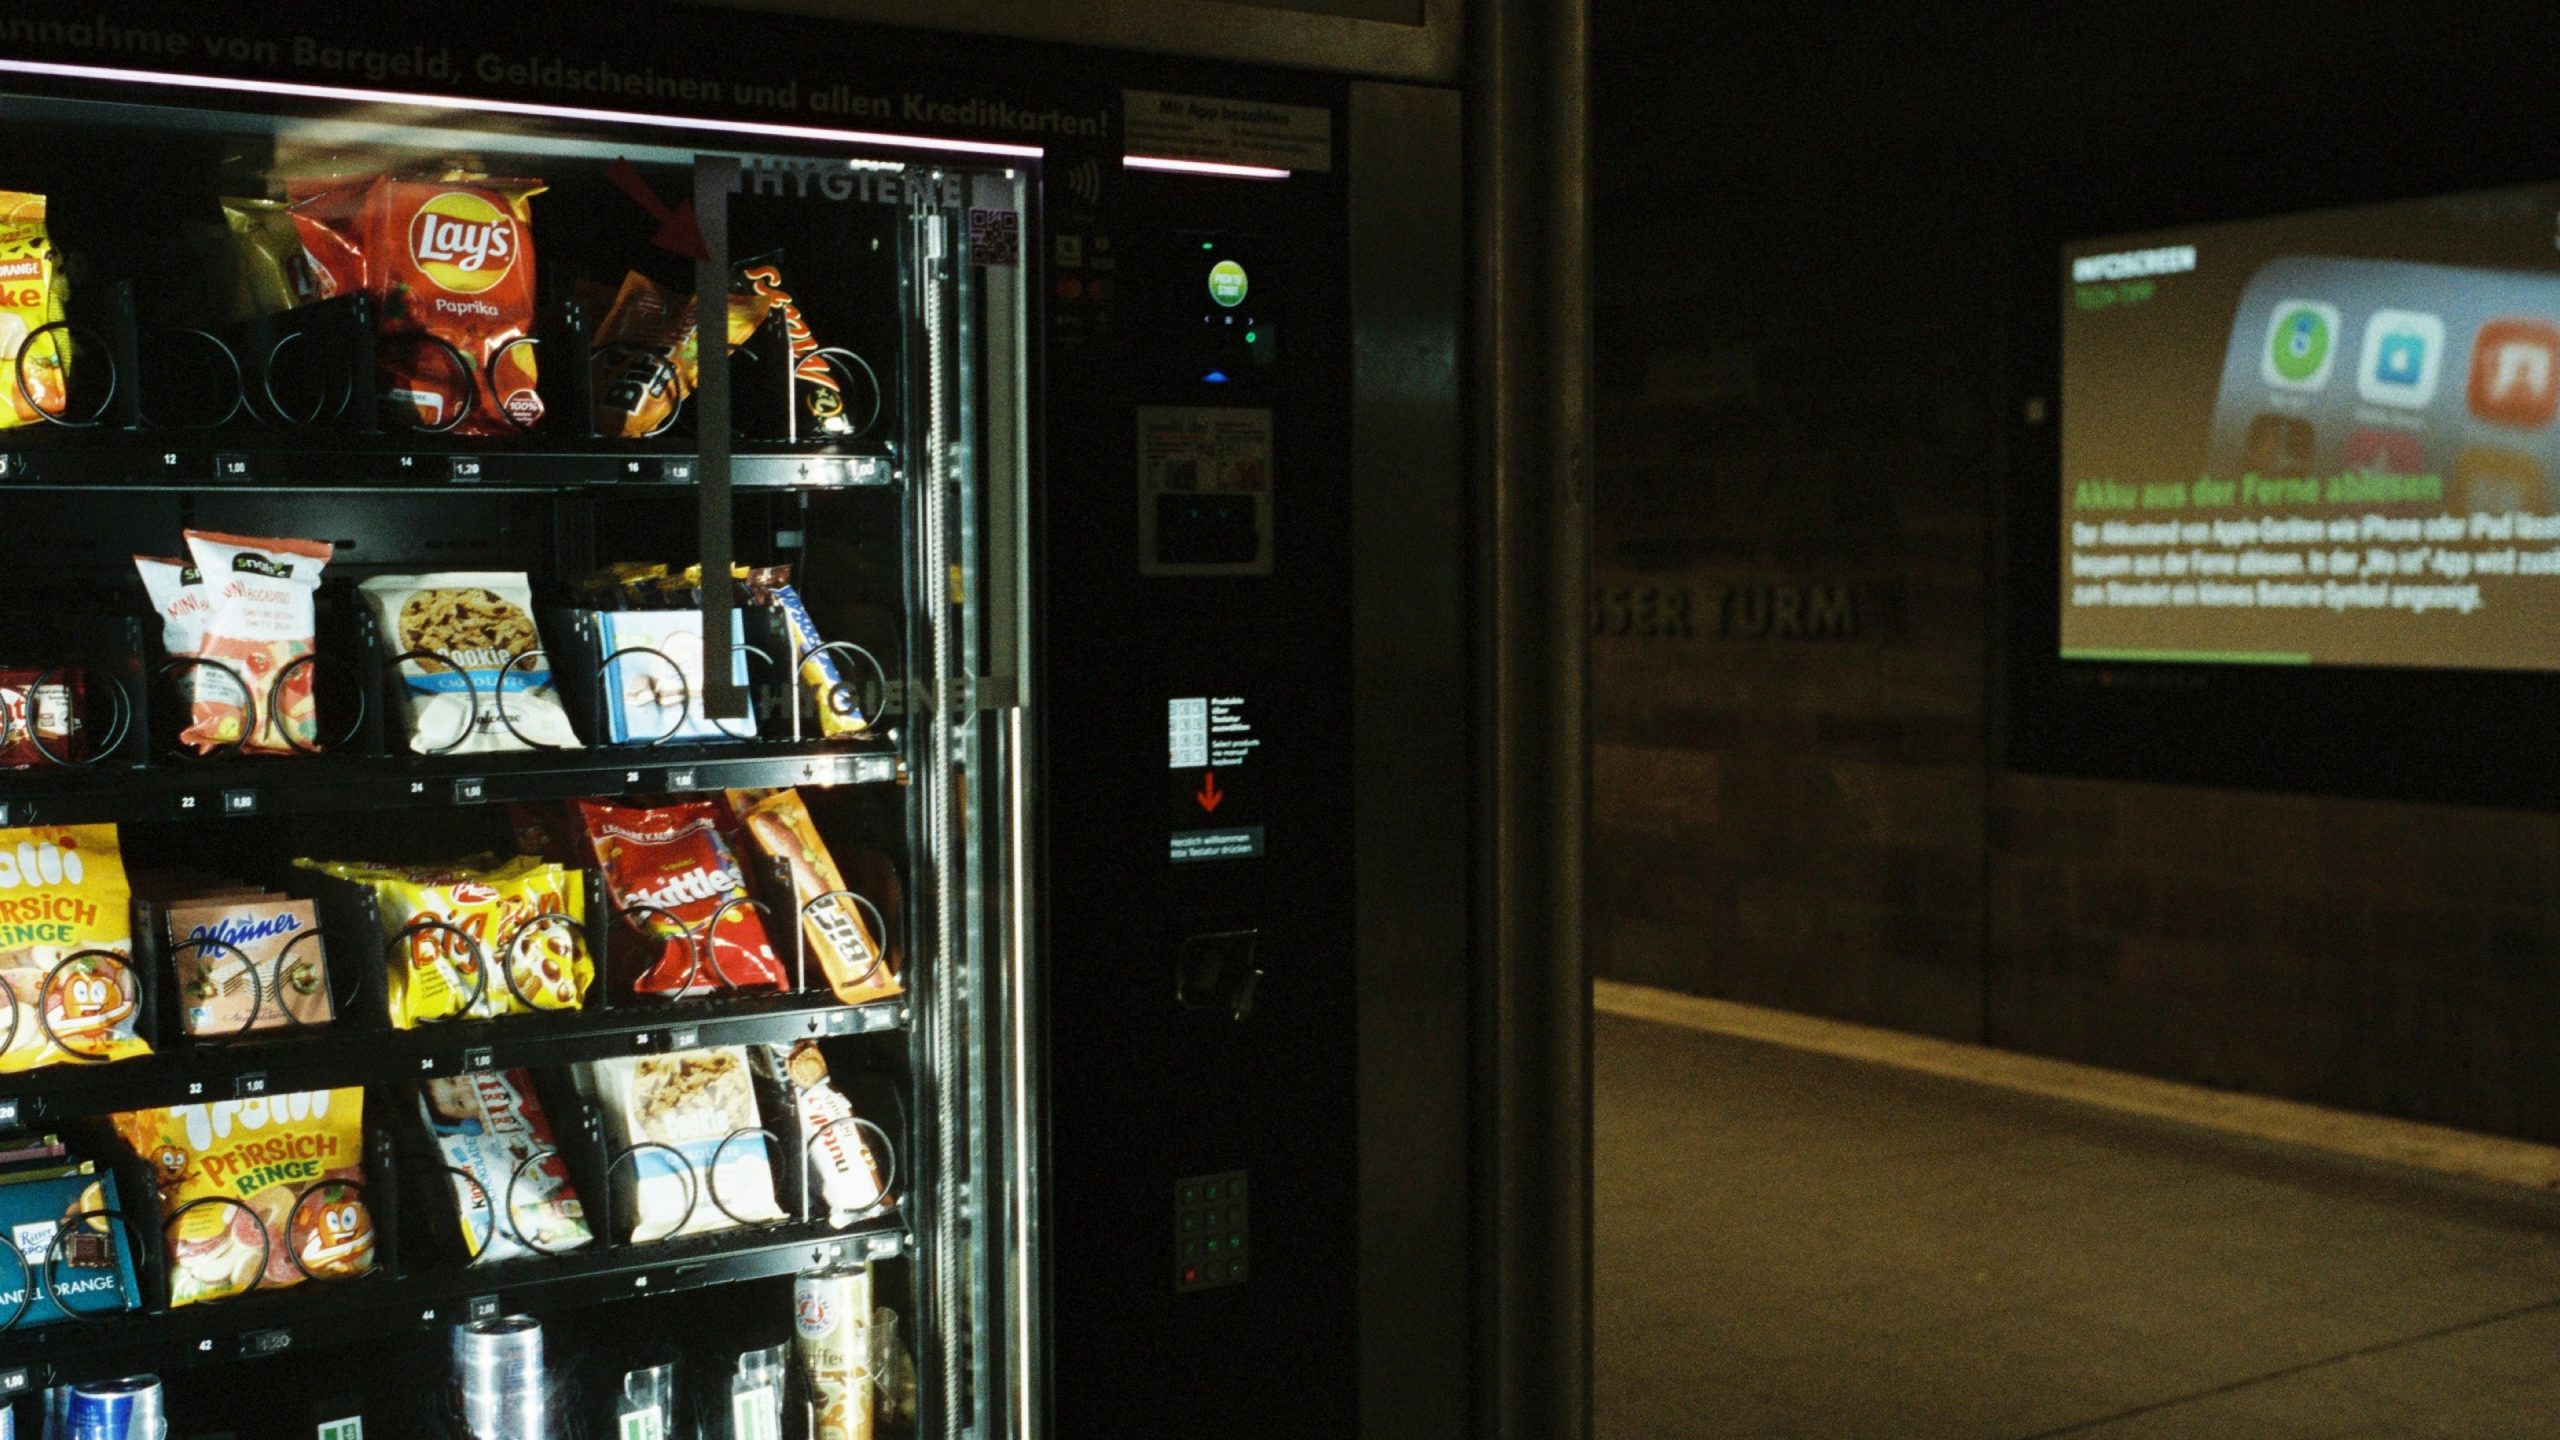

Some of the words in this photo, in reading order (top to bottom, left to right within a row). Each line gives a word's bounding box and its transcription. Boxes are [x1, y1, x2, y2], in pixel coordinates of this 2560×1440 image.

[0, 14, 191, 56] nnahme
[204, 33, 278, 63] von
[293, 36, 462, 84] Bargeld,
[475, 51, 721, 103] Geldscheinen
[734, 80, 798, 111] und
[809, 83, 892, 118] allen
[902, 92, 1109, 138] Kreditkarten!
[752, 159, 964, 209] HYGIENE
[418, 213, 510, 271] Lay's
[435, 298, 499, 317] Paprika
[163, 453, 178, 465] 12
[400, 456, 413, 467] 14
[411, 782, 424, 793] 24
[182, 796, 195, 808] 22
[622, 866, 744, 922] Skittles
[0, 923, 76, 950] iNGE
[189, 913, 301, 959] Manner
[189, 1082, 203, 1094] 32
[20, 1227, 53, 1247] Ritter
[21, 1244, 52, 1257] SPO
[198, 1338, 213, 1351] 42
